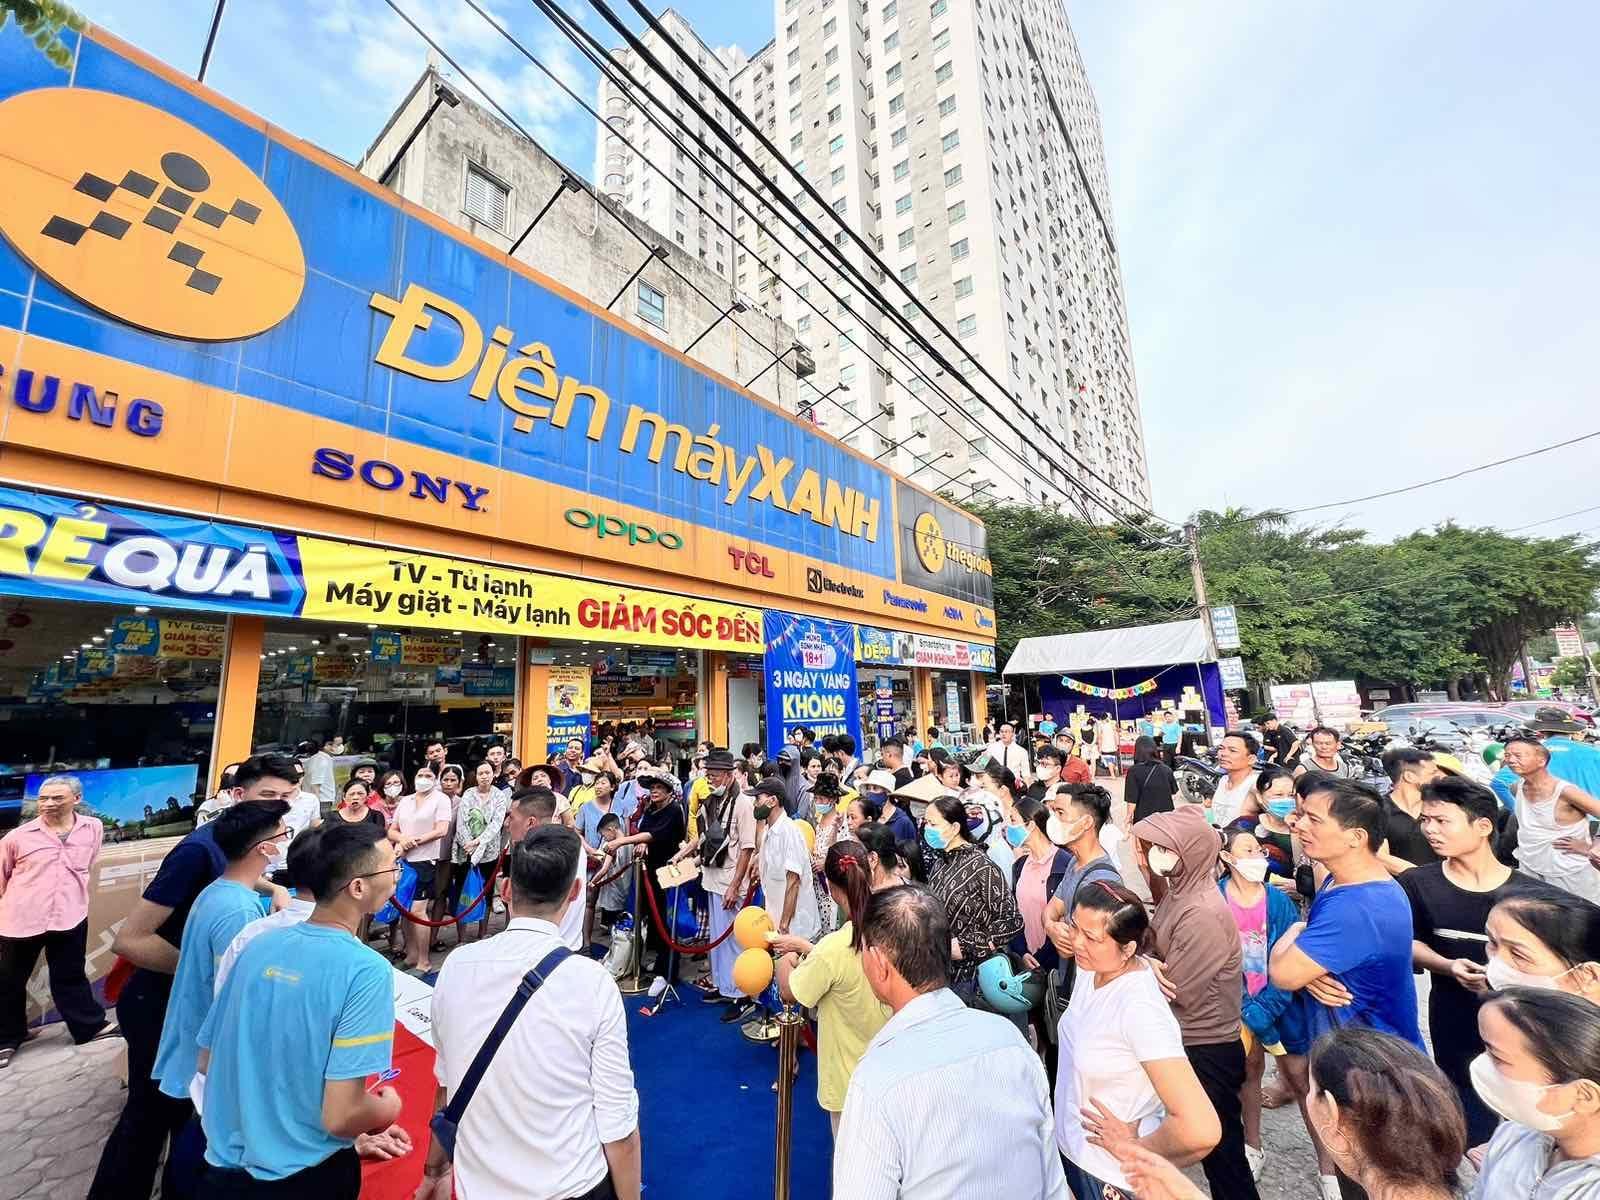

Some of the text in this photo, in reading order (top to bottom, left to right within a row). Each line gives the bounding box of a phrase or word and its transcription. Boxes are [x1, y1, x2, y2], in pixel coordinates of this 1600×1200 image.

[369, 282, 611, 441] Điện
[0, 364, 165, 438] UNG
[312, 447, 490, 512] SONY
[103, 537, 272, 599] QUÁ
[388, 560, 427, 584] TV
[448, 568, 478, 592] Tủ
[483, 573, 533, 599] lạnh
[728, 547, 776, 578] TCL
[326, 580, 393, 613] Máy
[397, 590, 453, 618] giặt
[473, 597, 522, 624] Máy
[526, 603, 571, 628] lạnh
[577, 594, 761, 645] GIẢM SỐC ĐẾN
[773, 670, 850, 689] 3 NGÀY VÀNG
[804, 651, 823, 664] 18+1
[783, 690, 845, 719] KHÔNG
